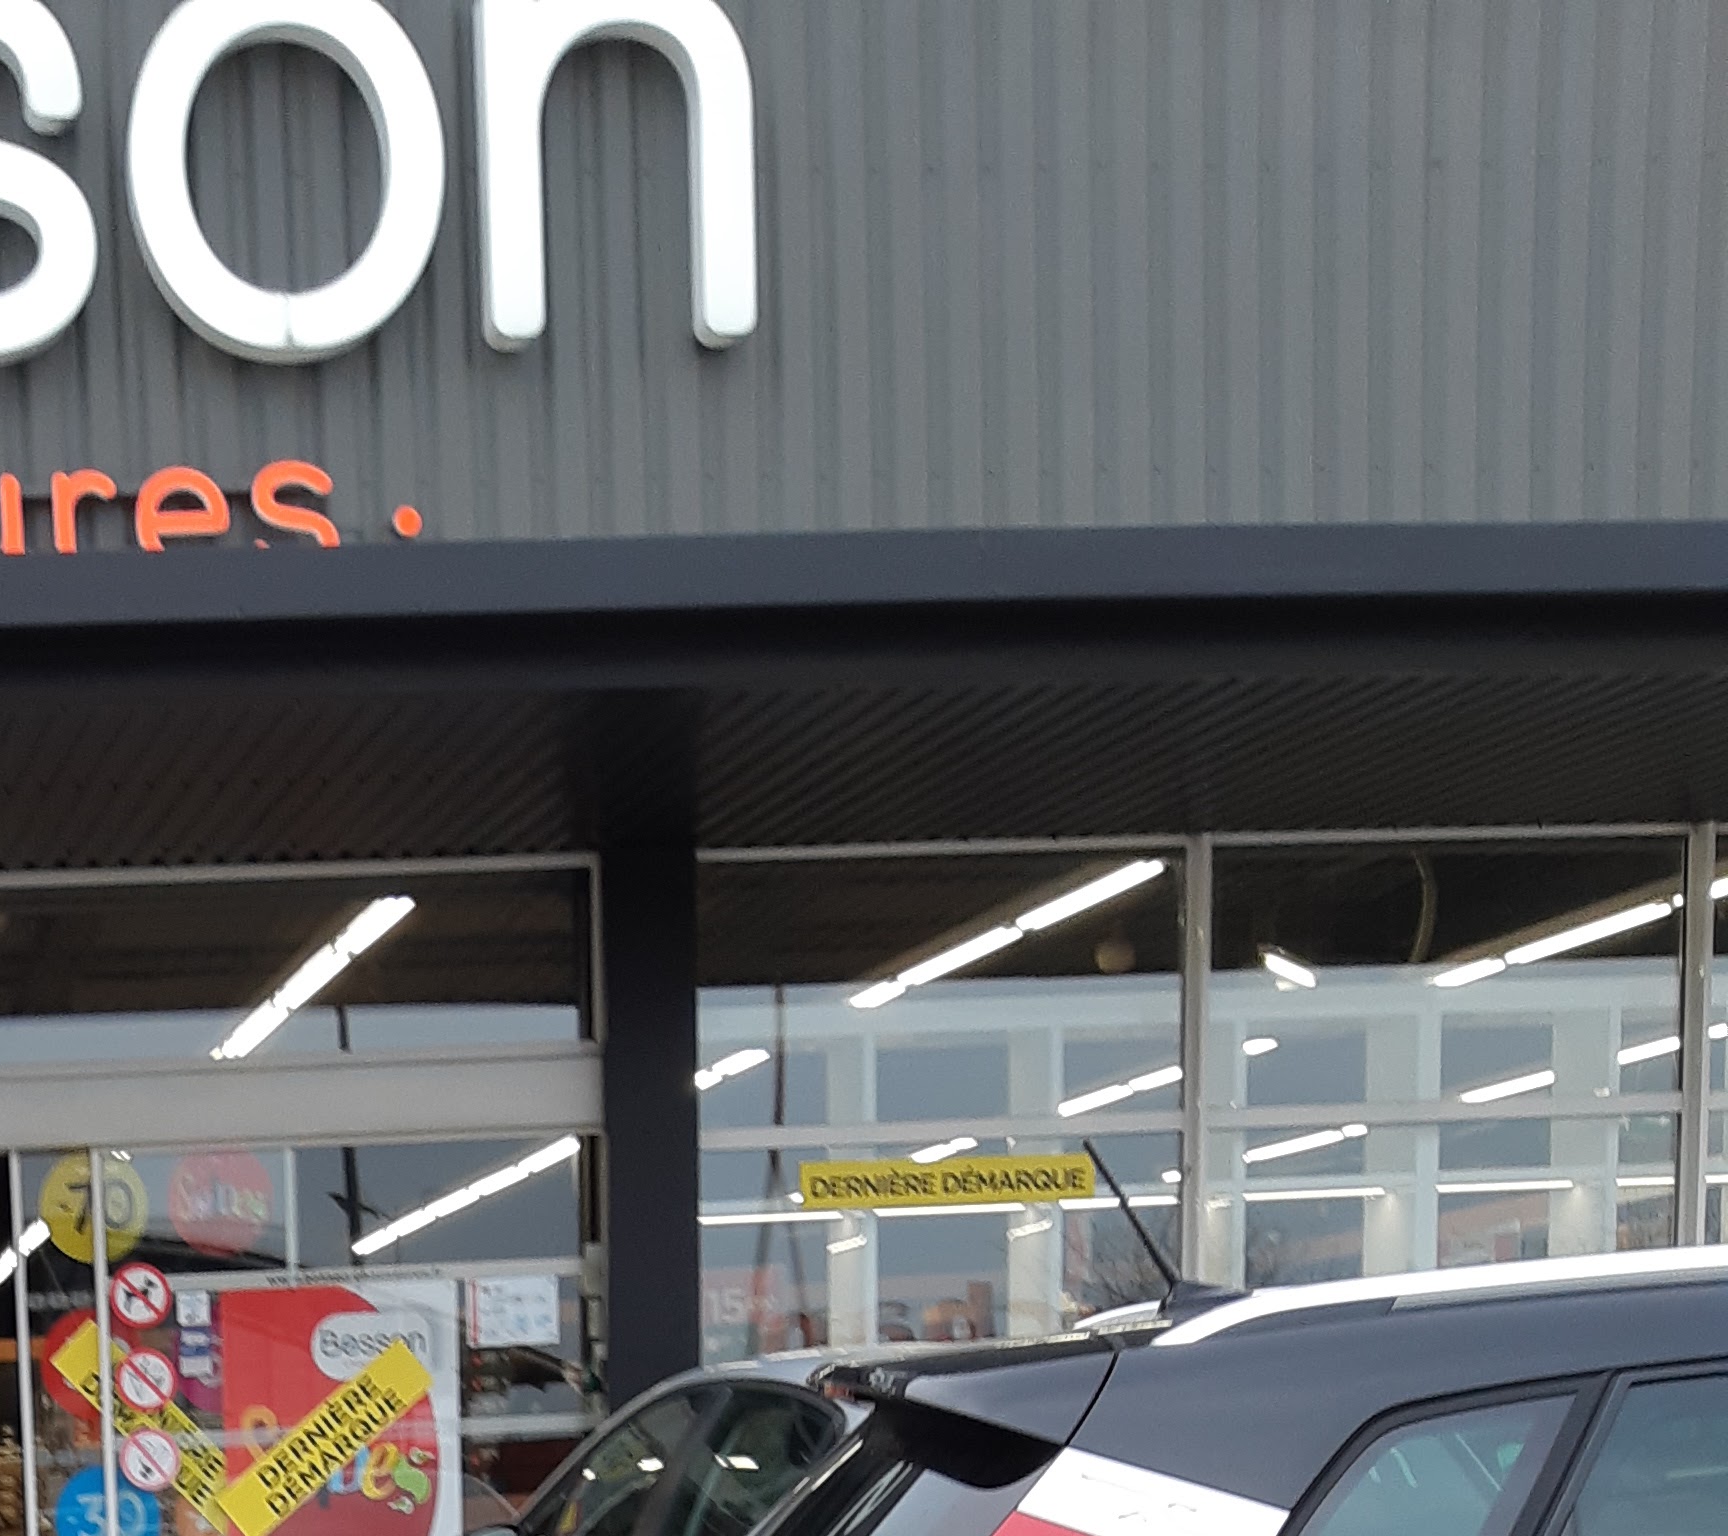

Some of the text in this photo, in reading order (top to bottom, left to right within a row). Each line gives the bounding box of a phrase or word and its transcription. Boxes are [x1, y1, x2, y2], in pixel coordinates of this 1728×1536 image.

[810, 1164, 1086, 1200] DERNIÈRE DÉMARQUE
[255, 1370, 381, 1490] DERNIÈRE
[265, 1386, 408, 1518] DÉMARQUE
